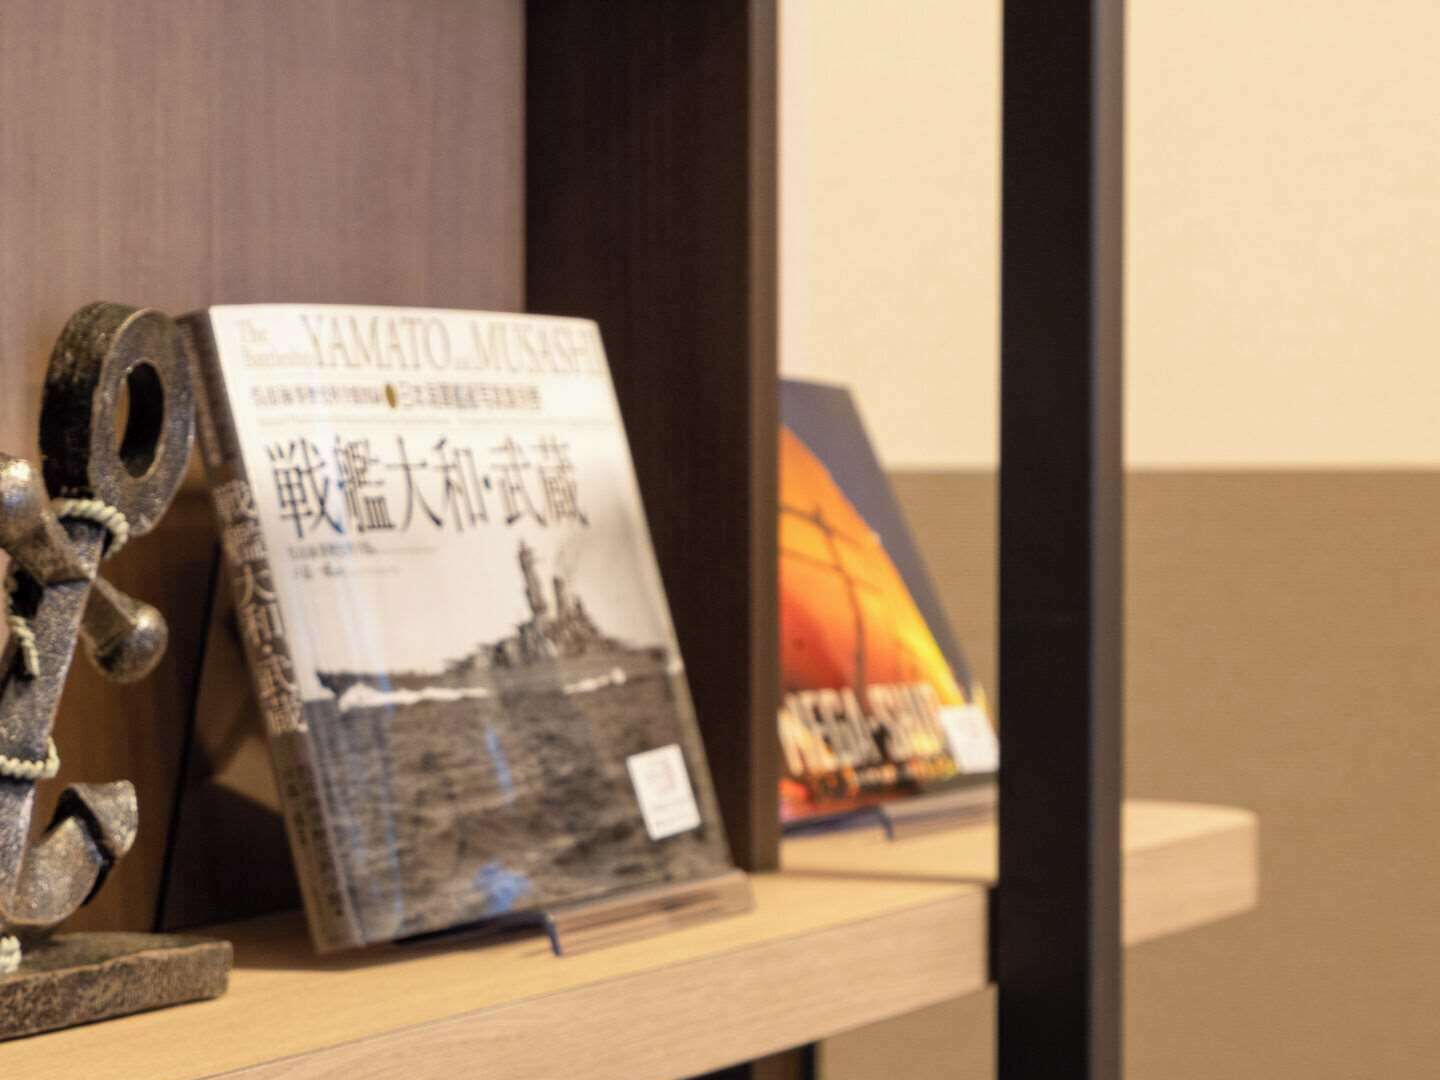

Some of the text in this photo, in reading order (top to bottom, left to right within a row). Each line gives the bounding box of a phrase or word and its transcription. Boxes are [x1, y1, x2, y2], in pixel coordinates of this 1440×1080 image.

[300, 313, 453, 370] YAMATO
[266, 433, 591, 539] 戦艦大和・武蔵
